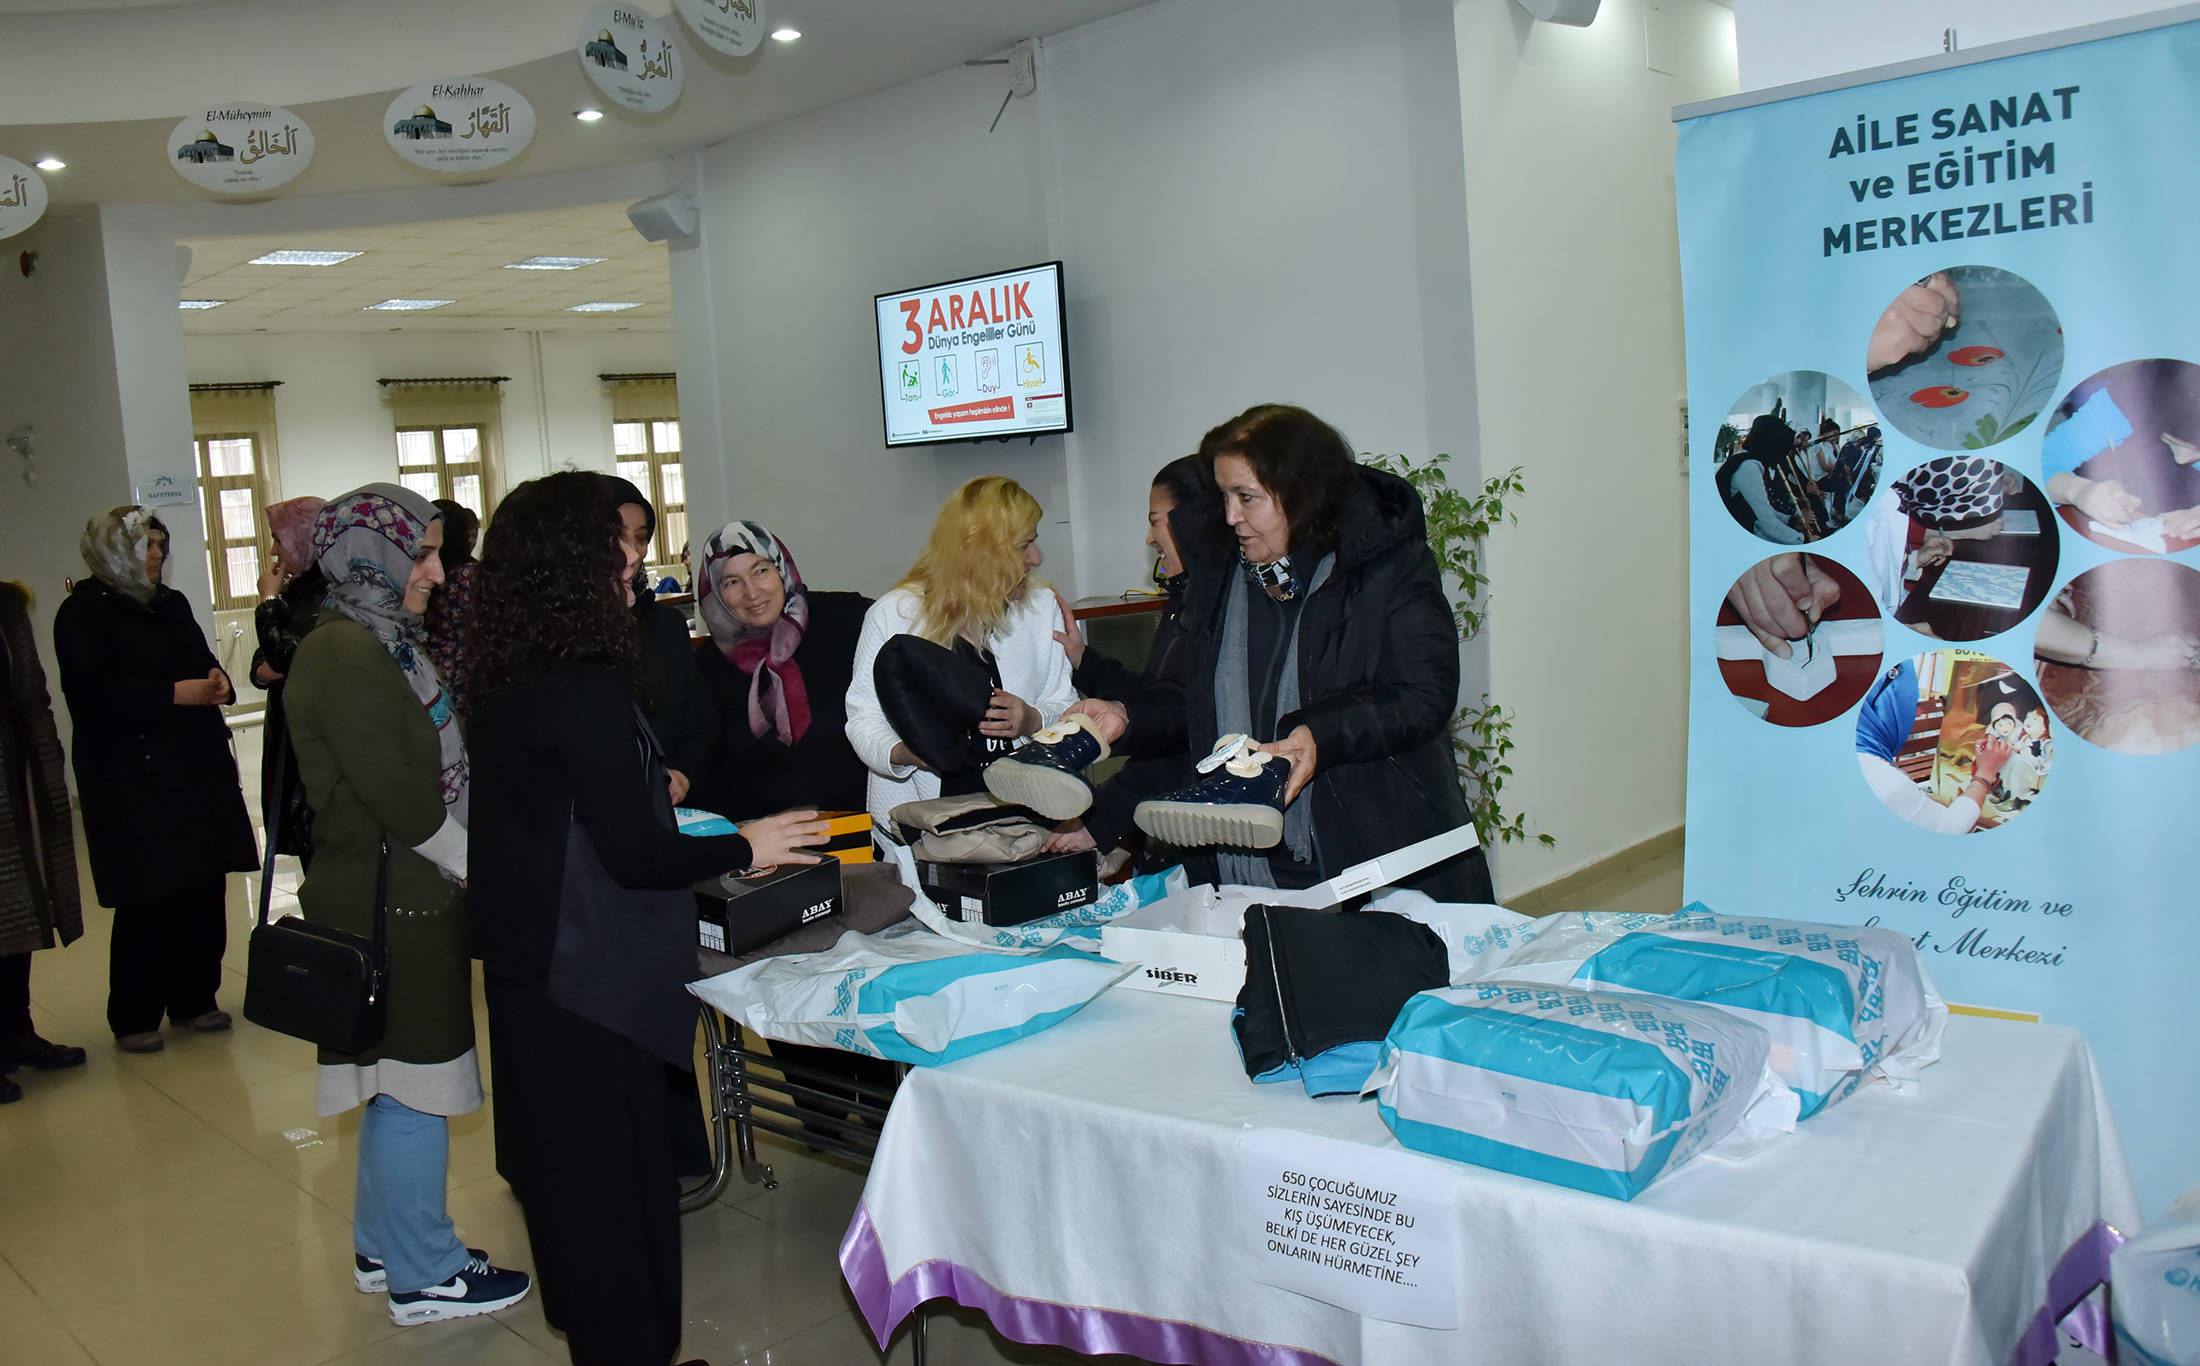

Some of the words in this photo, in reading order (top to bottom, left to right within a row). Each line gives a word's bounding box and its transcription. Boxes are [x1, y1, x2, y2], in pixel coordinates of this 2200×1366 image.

[432, 84, 486, 97] El-Kahhar
[206, 109, 272, 122] El-Müheymin
[1828, 113, 1919, 159] AİLE
[1931, 85, 2080, 140] SANAT
[1849, 175, 1894, 202] ve
[1908, 139, 2055, 195] EĞİTİM
[1823, 181, 2093, 257] MERKEZLERİ
[900, 298, 923, 355] 3
[927, 281, 1033, 334] ARALIK
[928, 335, 959, 350] Dünya
[1007, 320, 1035, 338] Günü
[942, 388, 955, 398] Gör
[982, 384, 997, 393] Duy
[1023, 378, 1042, 388] Hisset
[802, 899, 832, 919] ABAY
[1058, 888, 1087, 903] ABAY
[1835, 868, 1928, 902] Şehrin
[1937, 875, 2031, 918] Eğitim
[2040, 901, 2073, 917] ve
[1934, 927, 2067, 966] Merkezi
[1267, 1185, 1320, 1208] SİZLERİN
[1323, 1198, 1391, 1223] SAYESİNDE
[1396, 1213, 1415, 1228] BU
[1282, 1171, 1306, 1186] 650
[1309, 1177, 1397, 1207] ÇOCUĞUMUZ
[1266, 1221, 1298, 1240] BELKİ
[1301, 1229, 1317, 1245] DE
[1321, 1234, 1346, 1252] HER
[1350, 1241, 1391, 1263] GÜZEL
[1395, 1251, 1420, 1268] ŞEY
[1284, 1207, 1302, 1224] KIŞ
[1306, 1210, 1396, 1246] ÜŞÜMEYECEK,
[1267, 1239, 1320, 1264] ONLARIN
